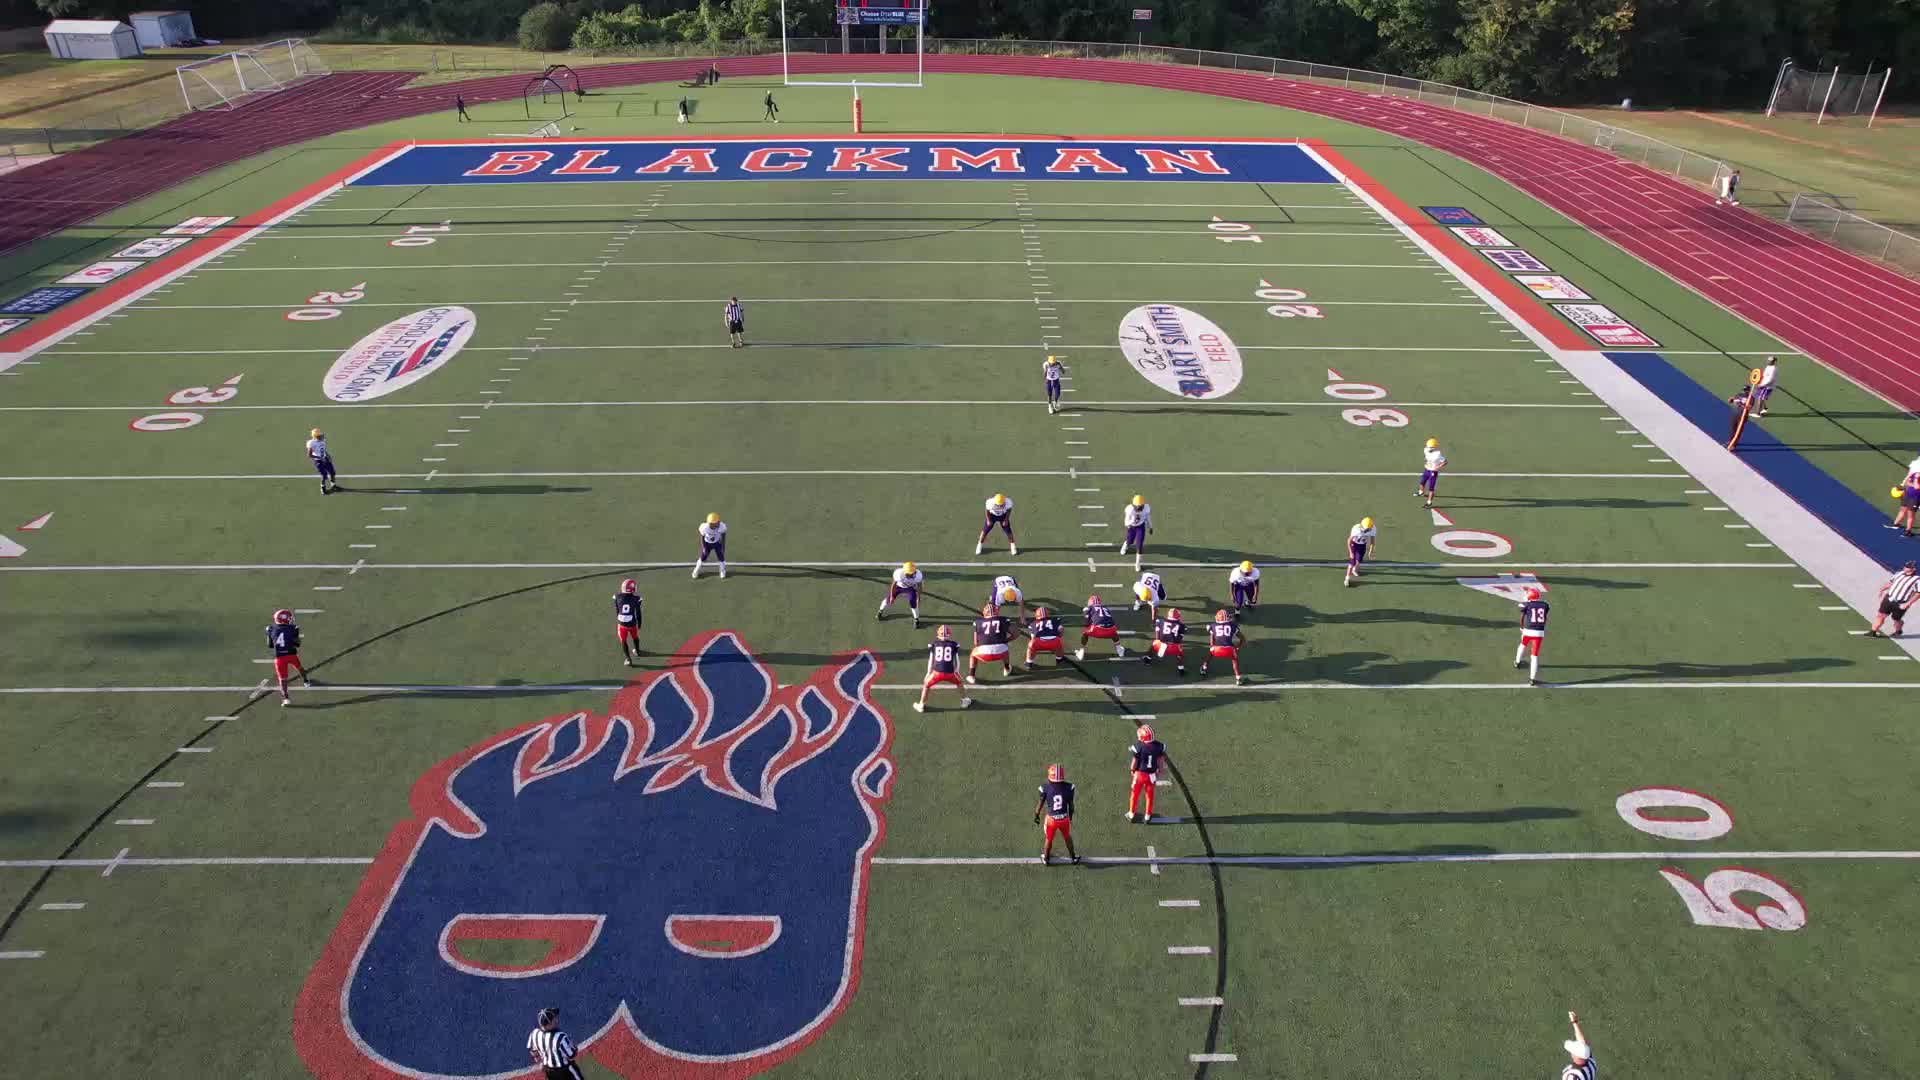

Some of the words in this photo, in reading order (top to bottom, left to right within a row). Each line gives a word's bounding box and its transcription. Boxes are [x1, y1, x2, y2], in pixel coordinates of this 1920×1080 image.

[462, 147, 1231, 177] BLACKMAN
[283, 289, 366, 322] 20
[1254, 287, 1327, 319] 20
[1147, 306, 1192, 346] SMITH
[1198, 333, 1232, 362] FIELD
[364, 351, 405, 376] BUICK
[1166, 348, 1214, 397] BART
[335, 377, 376, 399] GMC
[128, 386, 239, 432] 30
[1323, 381, 1411, 428] 30
[982, 620, 1001, 635] 77
[1035, 619, 1054, 632] 74
[1530, 607, 1545, 623] 13
[275, 631, 286, 648] 4
[934, 646, 952, 662] 88
[1052, 794, 1063, 811] 2
[1616, 785, 1809, 932] 50
